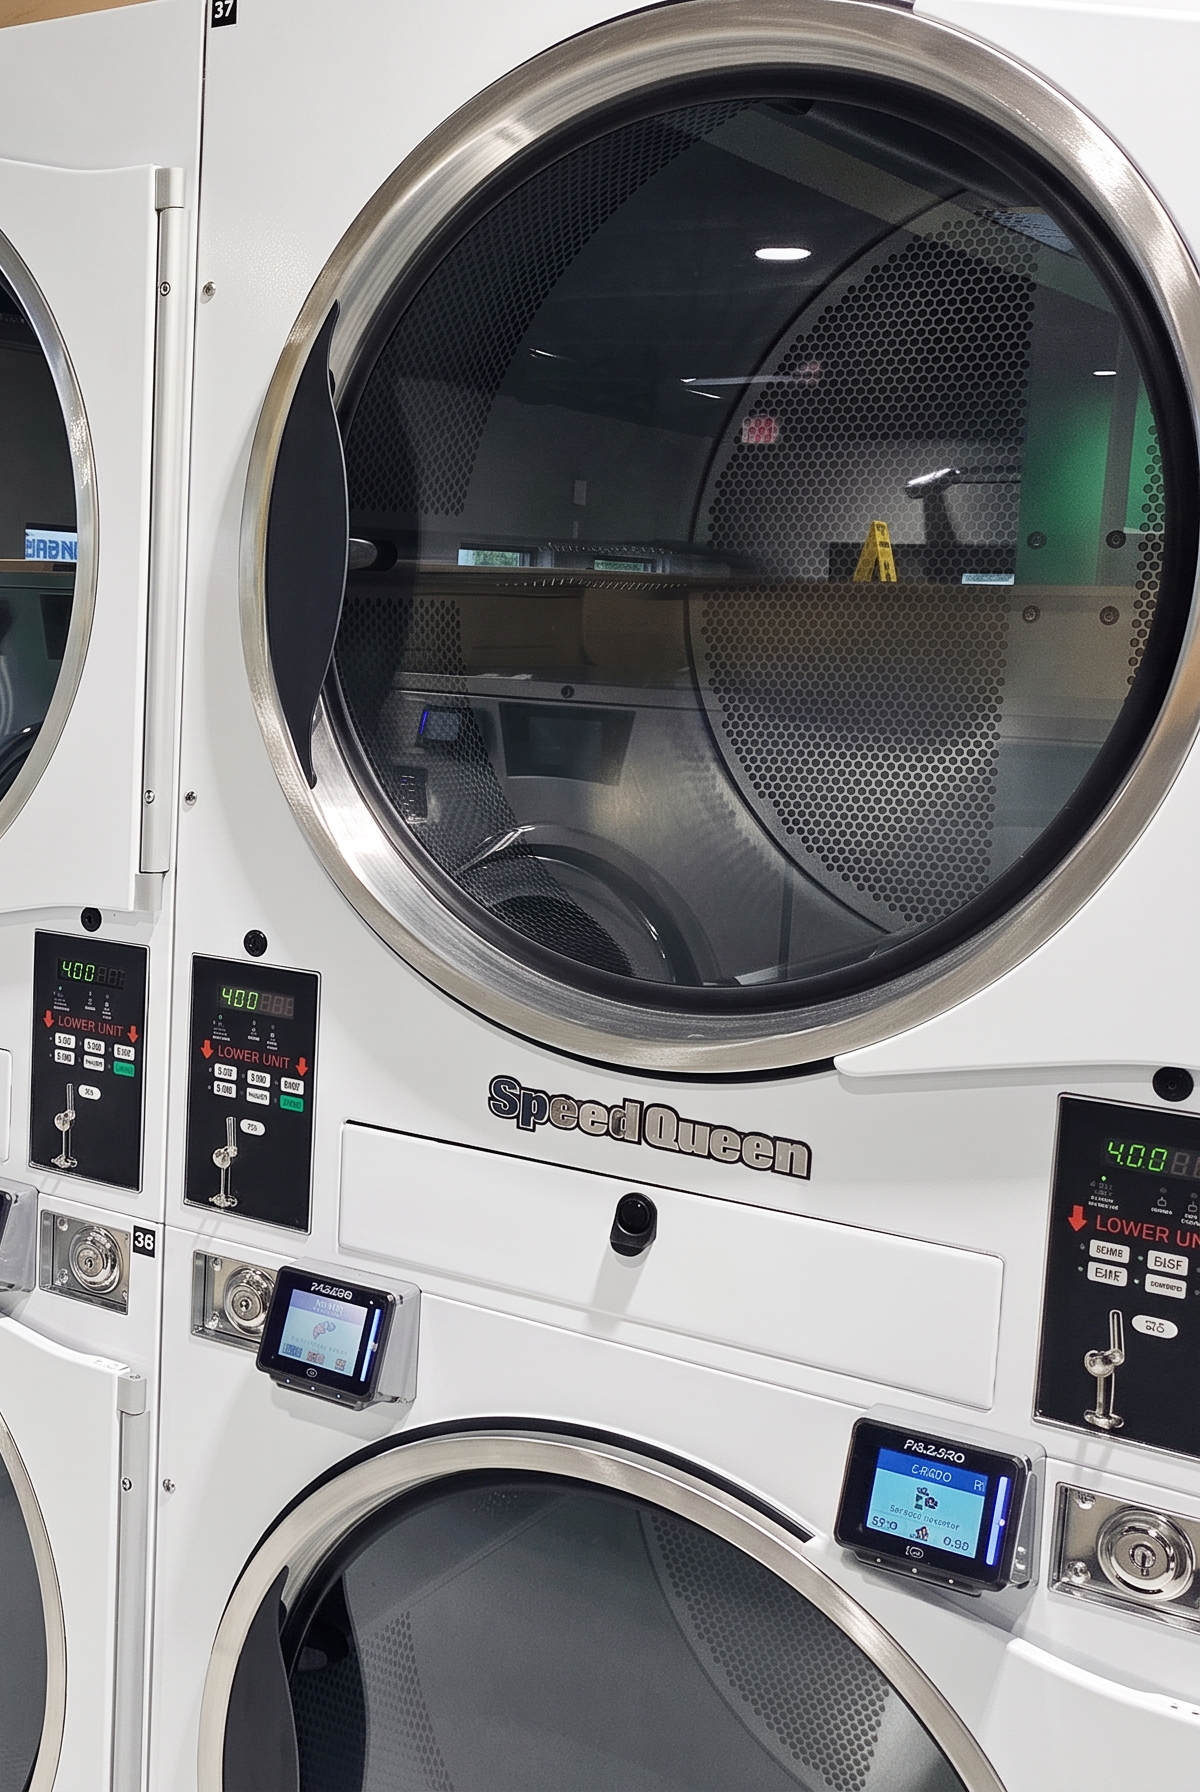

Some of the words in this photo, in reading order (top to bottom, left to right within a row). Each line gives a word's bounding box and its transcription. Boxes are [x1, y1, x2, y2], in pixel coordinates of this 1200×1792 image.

[214, 0, 234, 19] 37
[58, 1015, 96, 1032] LOWER
[98, 1022, 124, 1037] UNIT
[217, 1045, 260, 1064] LOWER
[262, 1053, 290, 1069] UNIT
[488, 1074, 644, 1146] Speed
[642, 1103, 813, 1180] Queen
[1095, 1214, 1170, 1243] LOWER
